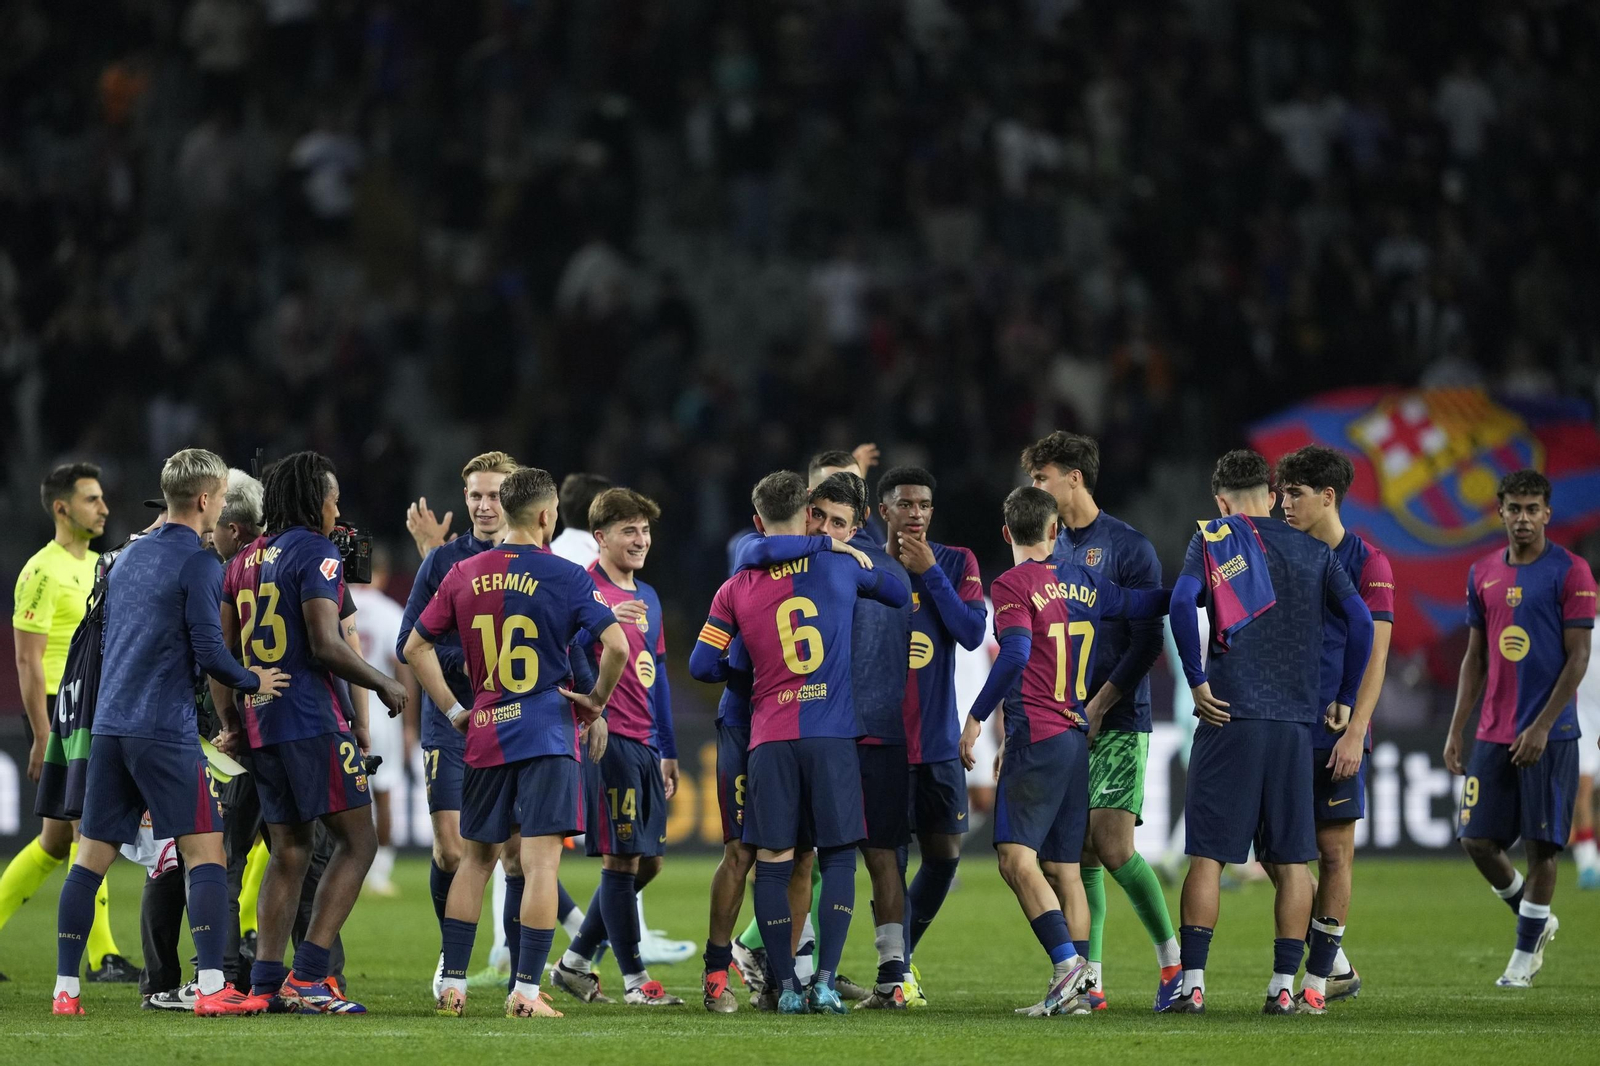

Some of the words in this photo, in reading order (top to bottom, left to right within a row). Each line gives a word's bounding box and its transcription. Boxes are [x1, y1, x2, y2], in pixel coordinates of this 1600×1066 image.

[769, 557, 809, 581] GAVI
[1216, 554, 1244, 574] UNHCR
[1221, 560, 1248, 580] ACNUR
[471, 572, 539, 596] FERMÍN
[236, 582, 287, 669] 23
[776, 596, 824, 675] 6
[471, 614, 539, 694] 16
[1047, 620, 1095, 702] 17
[796, 690, 828, 699] ACNUR
[491, 702, 521, 715] UNHCR
[492, 709, 522, 722] ACNUR
[607, 787, 637, 820] 14
